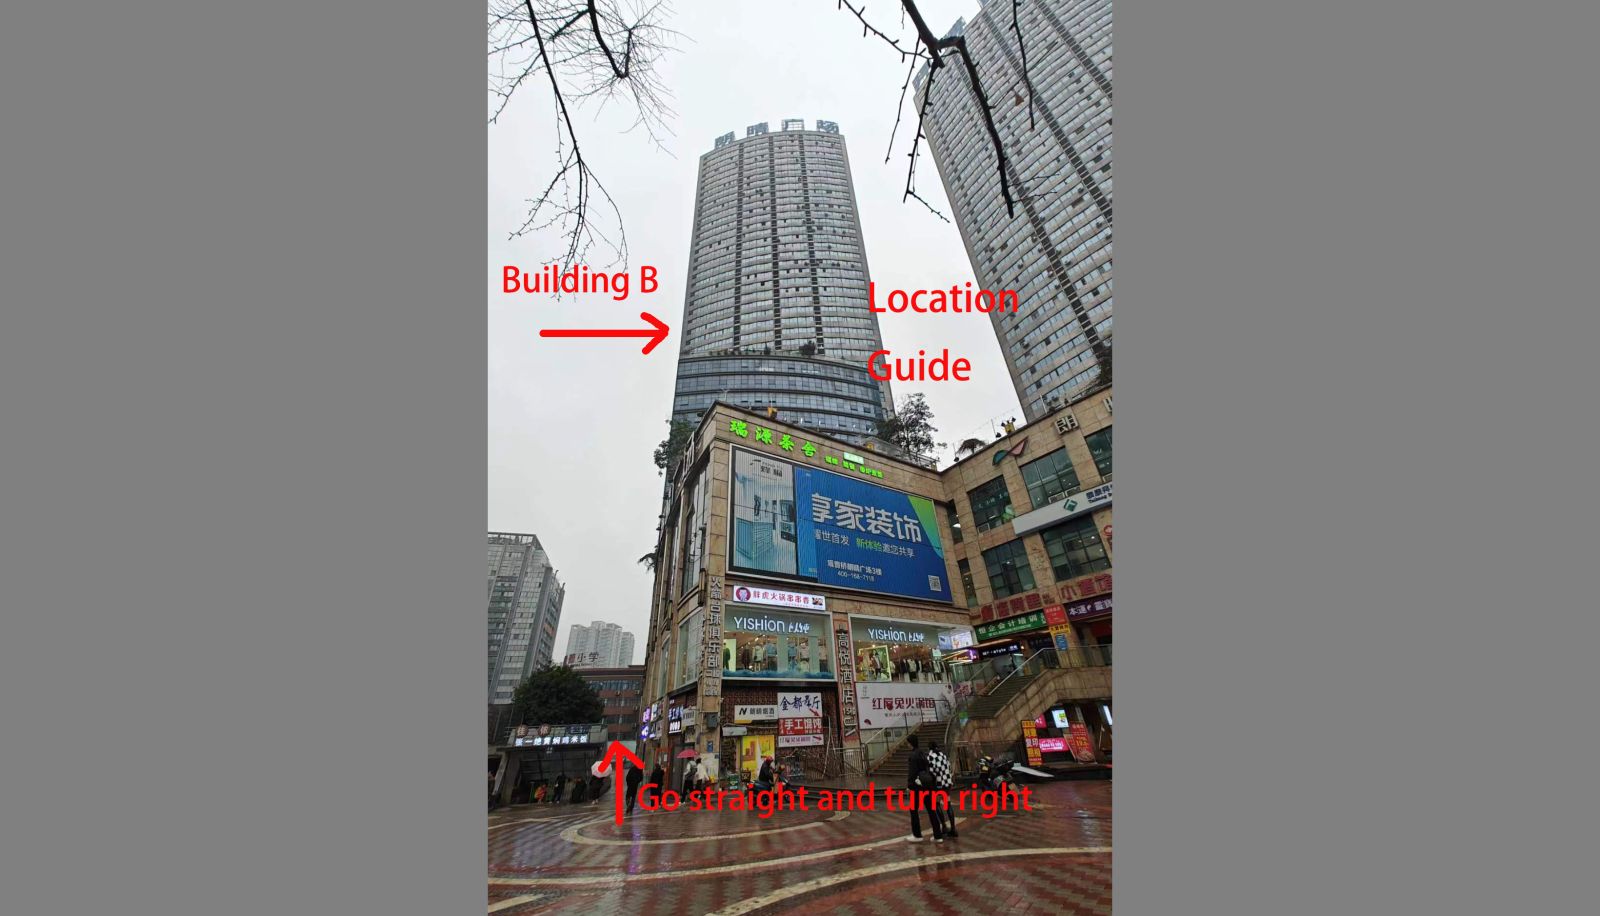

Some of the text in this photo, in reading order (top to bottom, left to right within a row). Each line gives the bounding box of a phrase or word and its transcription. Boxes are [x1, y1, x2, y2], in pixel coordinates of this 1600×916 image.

[729, 419, 817, 457] 瑞源茶舍
[811, 492, 923, 543] 享家装饰
